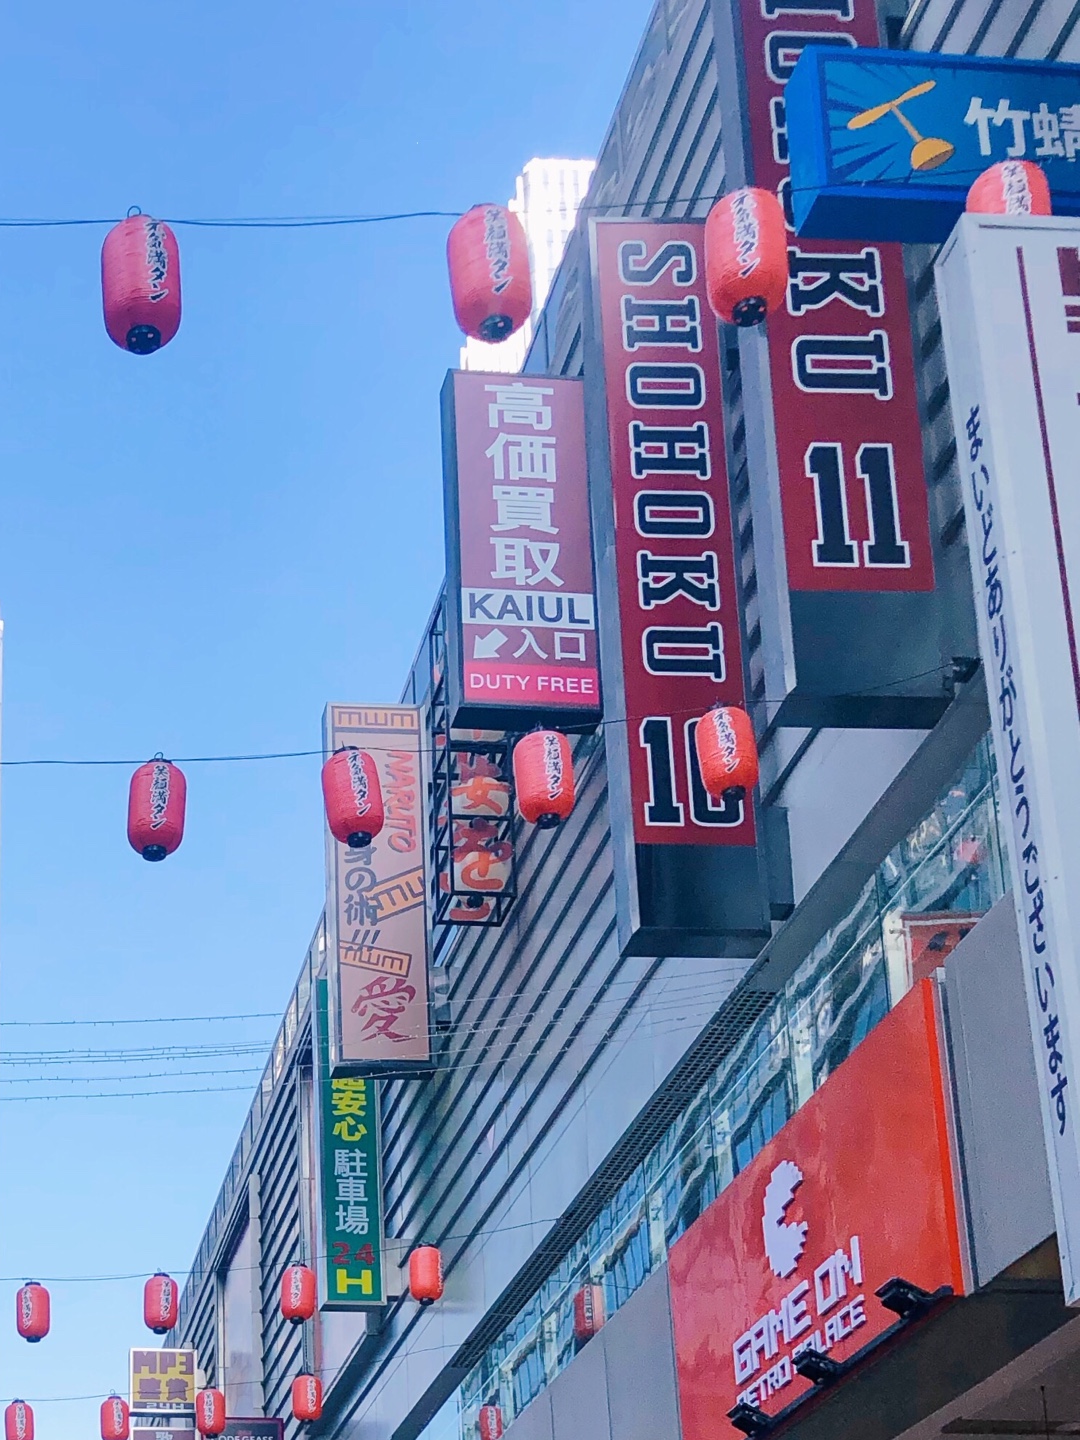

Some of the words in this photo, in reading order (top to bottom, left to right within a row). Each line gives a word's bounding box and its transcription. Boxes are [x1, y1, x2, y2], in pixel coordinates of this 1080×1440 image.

[483, 383, 565, 590] 高価買取
[620, 240, 726, 683] SHOHOKU
[803, 441, 911, 569] 11
[469, 594, 591, 625] KAIUL
[513, 627, 587, 662] 入口
[470, 671, 528, 691] DUTY
[535, 673, 595, 694] FREE
[640, 716, 748, 828] 10
[350, 975, 416, 1043] 愛
[333, 1149, 370, 1235] 駐車場
[732, 1279, 812, 1385] GAME
[814, 1235, 863, 1316] ON
[133, 1351, 194, 1376] MP3
